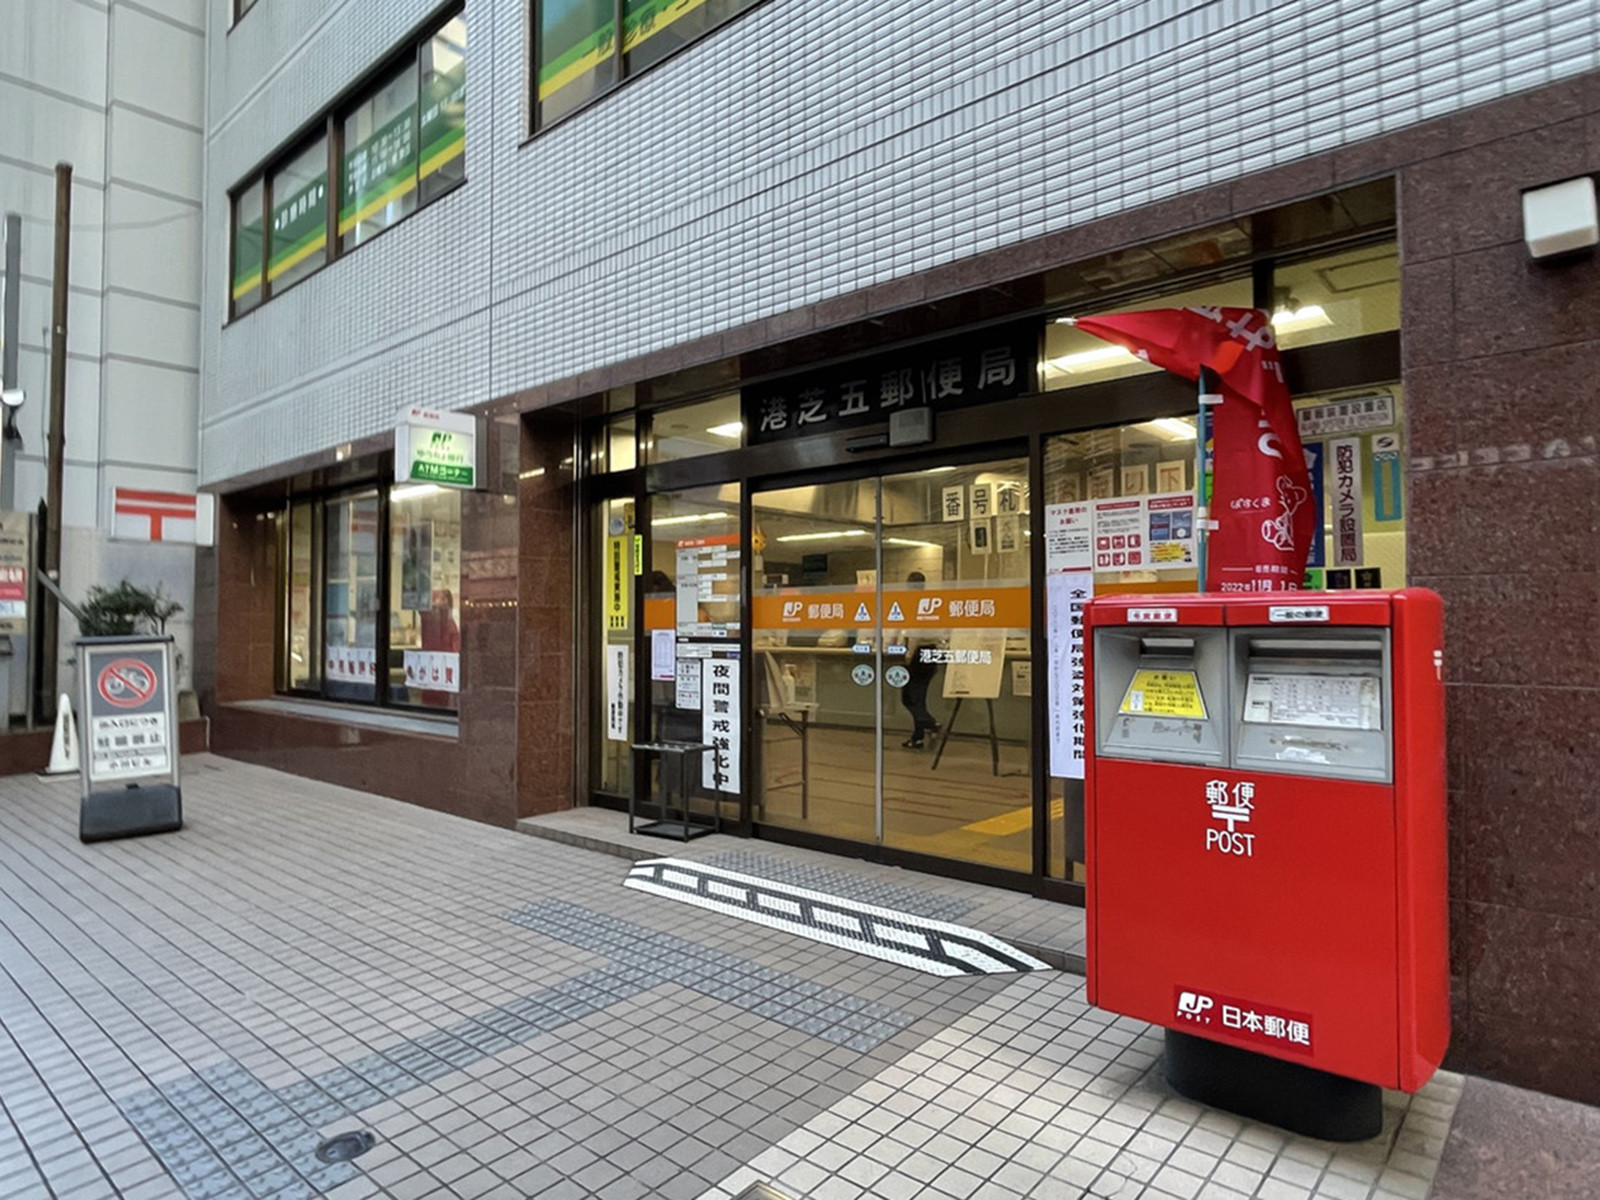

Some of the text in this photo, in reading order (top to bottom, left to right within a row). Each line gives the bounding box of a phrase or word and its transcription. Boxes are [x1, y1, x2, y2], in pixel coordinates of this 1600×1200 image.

[760, 347, 1016, 432] 港芝五郵便局
[945, 488, 1016, 516] 番号札
[807, 603, 844, 619] 郵便局
[948, 599, 996, 618] 郵便局
[918, 649, 993, 666] 港芝五郵便局
[1206, 780, 1255, 810] 郵便
[1206, 828, 1255, 857] POST
[1222, 1004, 1311, 1046] 日本郵便
